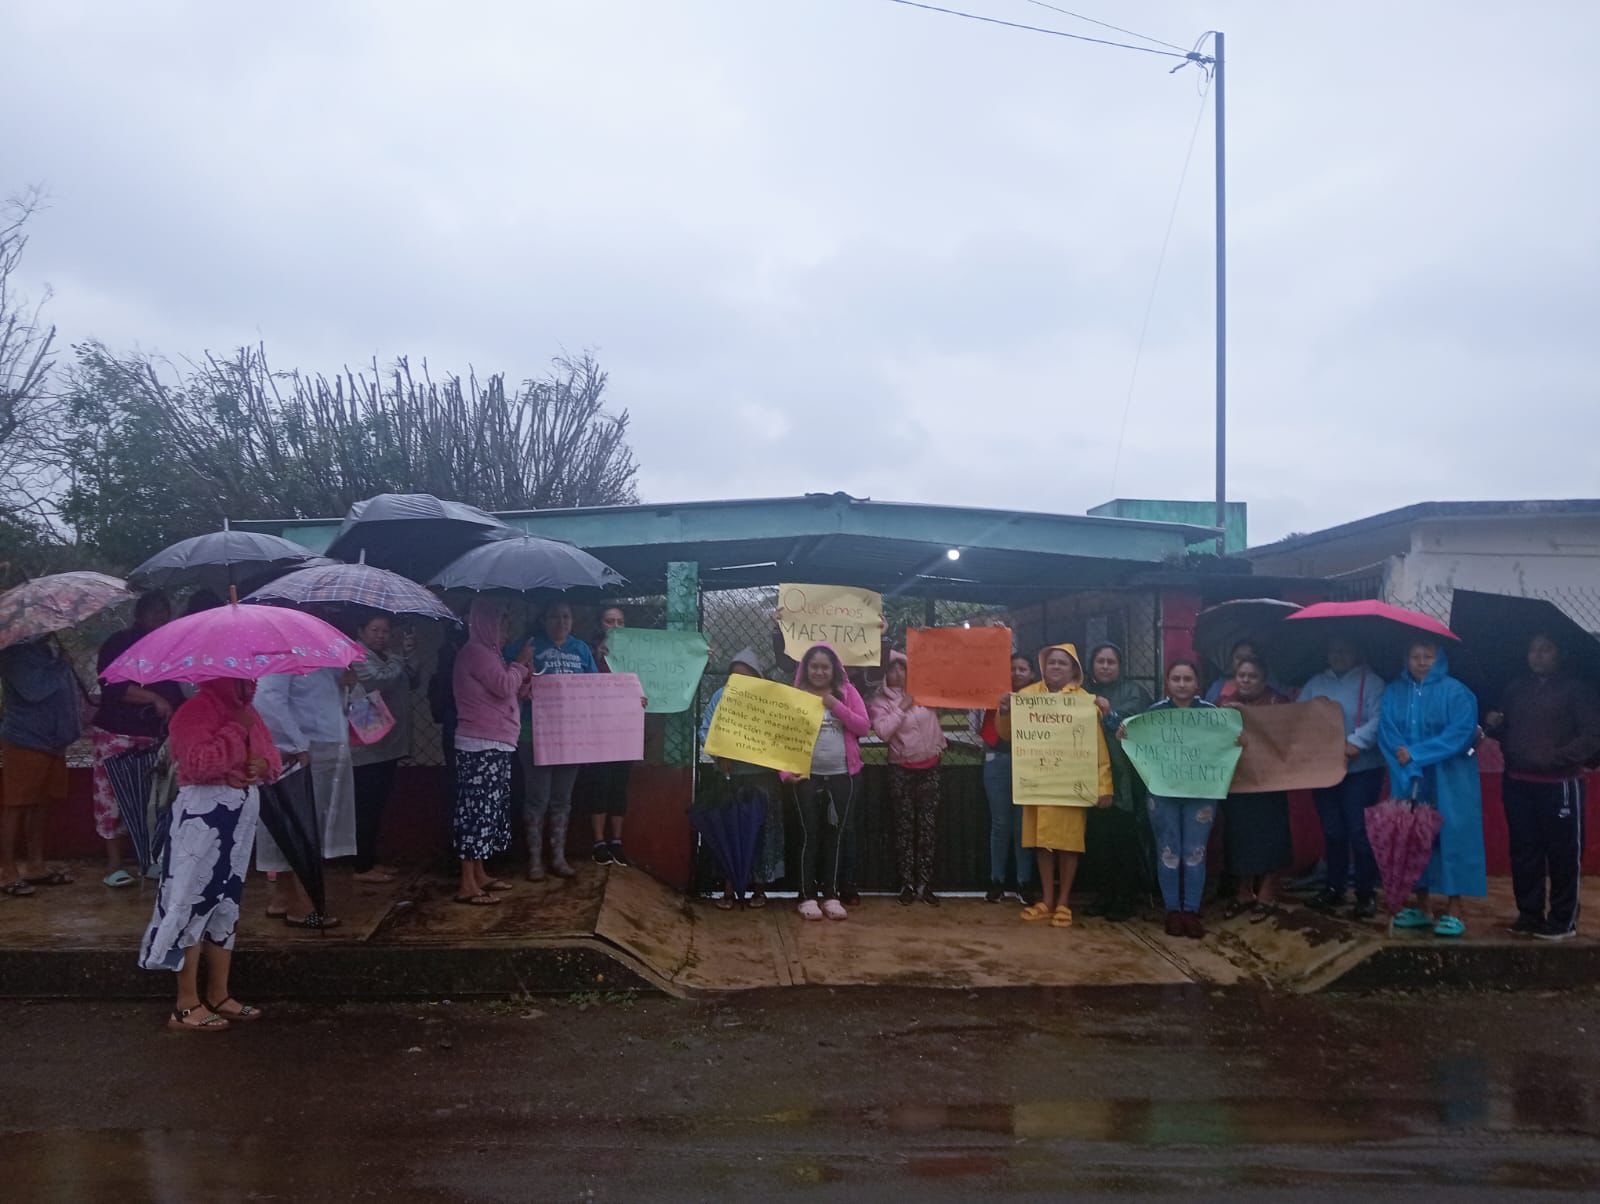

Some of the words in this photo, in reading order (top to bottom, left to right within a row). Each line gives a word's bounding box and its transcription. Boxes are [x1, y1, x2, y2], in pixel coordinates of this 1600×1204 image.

[781, 621, 867, 644] MAESTRA
[1015, 695, 1057, 709] Exigimos
[1063, 696, 1077, 707] un
[1029, 712, 1074, 724] Maestro
[1015, 729, 1052, 740] Nuevo
[1161, 727, 1184, 745] UN
[1160, 762, 1228, 783] URGENTE
